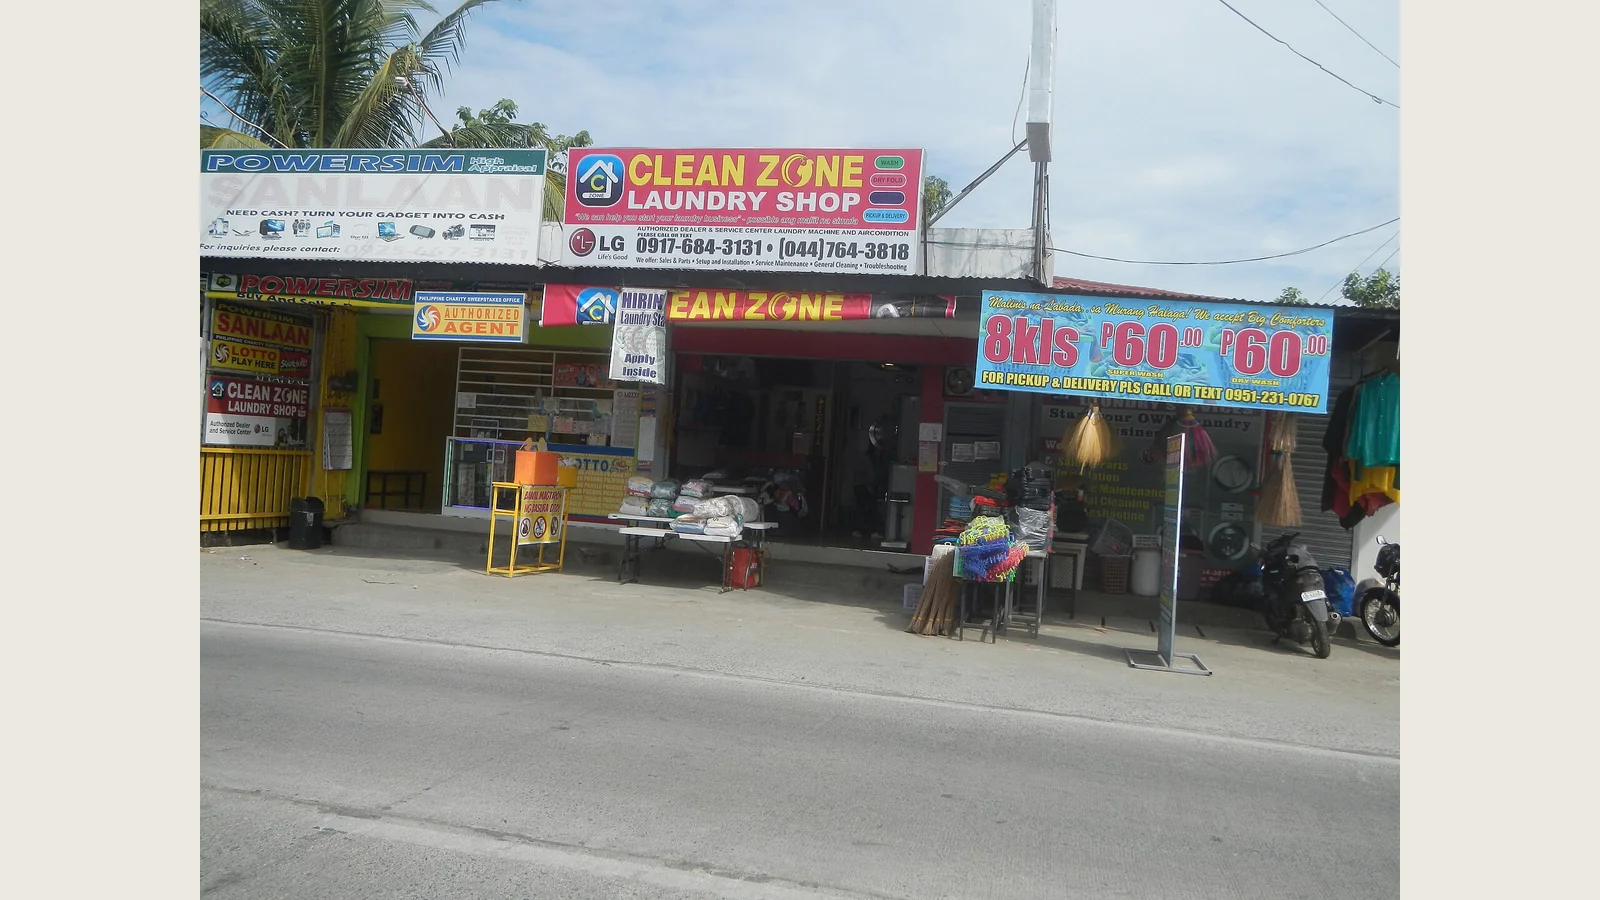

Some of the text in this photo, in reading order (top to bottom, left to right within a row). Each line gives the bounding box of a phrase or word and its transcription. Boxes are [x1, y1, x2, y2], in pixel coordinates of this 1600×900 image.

[206, 154, 465, 172] POWERSIM
[468, 164, 538, 173] Appraisal
[470, 157, 504, 168] High
[628, 153, 865, 188] CLEAN ZONE
[590, 174, 605, 191] C
[207, 175, 535, 212] SANLAAN
[627, 191, 861, 213] LAUNDRY SHOP
[606, 213, 622, 223] help
[623, 215, 636, 223] you
[639, 213, 655, 221] start
[656, 215, 673, 223] your
[675, 213, 703, 223] laundry
[746, 215, 778, 225] possible
[781, 217, 795, 226] ang
[217, 244, 260, 253] inquiries
[263, 245, 297, 254] please
[300, 245, 340, 253] contact:
[599, 236, 625, 251] LG
[636, 237, 909, 261] 0917-684-3131 (044)764-3818
[833, 261, 858, 269] Cleaning
[864, 262, 907, 271] Troubleshooting
[240, 274, 413, 300] POWERSIM
[621, 292, 665, 311] HIRIN
[669, 291, 845, 321] EAN ZONE
[218, 304, 294, 323] POWERSIM
[444, 307, 520, 321] AUTHORIZED
[589, 305, 603, 320] C
[620, 311, 652, 326] Laundry
[988, 295, 1027, 309] Malinis
[1029, 302, 1042, 310] na
[1090, 305, 1102, 313] sa
[1104, 302, 1145, 320] Murang
[1147, 305, 1192, 322] Halaga!
[1194, 308, 1210, 320] We
[1213, 312, 1245, 324] accept
[1247, 310, 1266, 326] Big
[1269, 312, 1326, 328] Comforters
[217, 313, 310, 346] SANLAAN
[444, 321, 519, 335] AGENT
[983, 314, 1080, 368] 8kls
[231, 346, 277, 361] LOTTO
[624, 353, 656, 366] Apply
[231, 357, 252, 368] PLAY
[254, 359, 276, 370] HERE
[622, 366, 657, 379] Inside
[1107, 369, 1165, 379] SUPER WASH
[981, 370, 1320, 407] FOR PICKUP & DELIVERY PLS CALL OR TEXT 0951-231-0767
[1231, 377, 1280, 387] DRY WASH
[227, 382, 308, 405] CLEAN ZONE
[228, 401, 272, 415] LAUNDRY
[274, 405, 297, 416] SHOP
[210, 420, 236, 428] Authorized
[1106, 413, 1132, 423] our
[1203, 418, 1252, 432] undry
[1100, 497, 1149, 510] Cleaning
